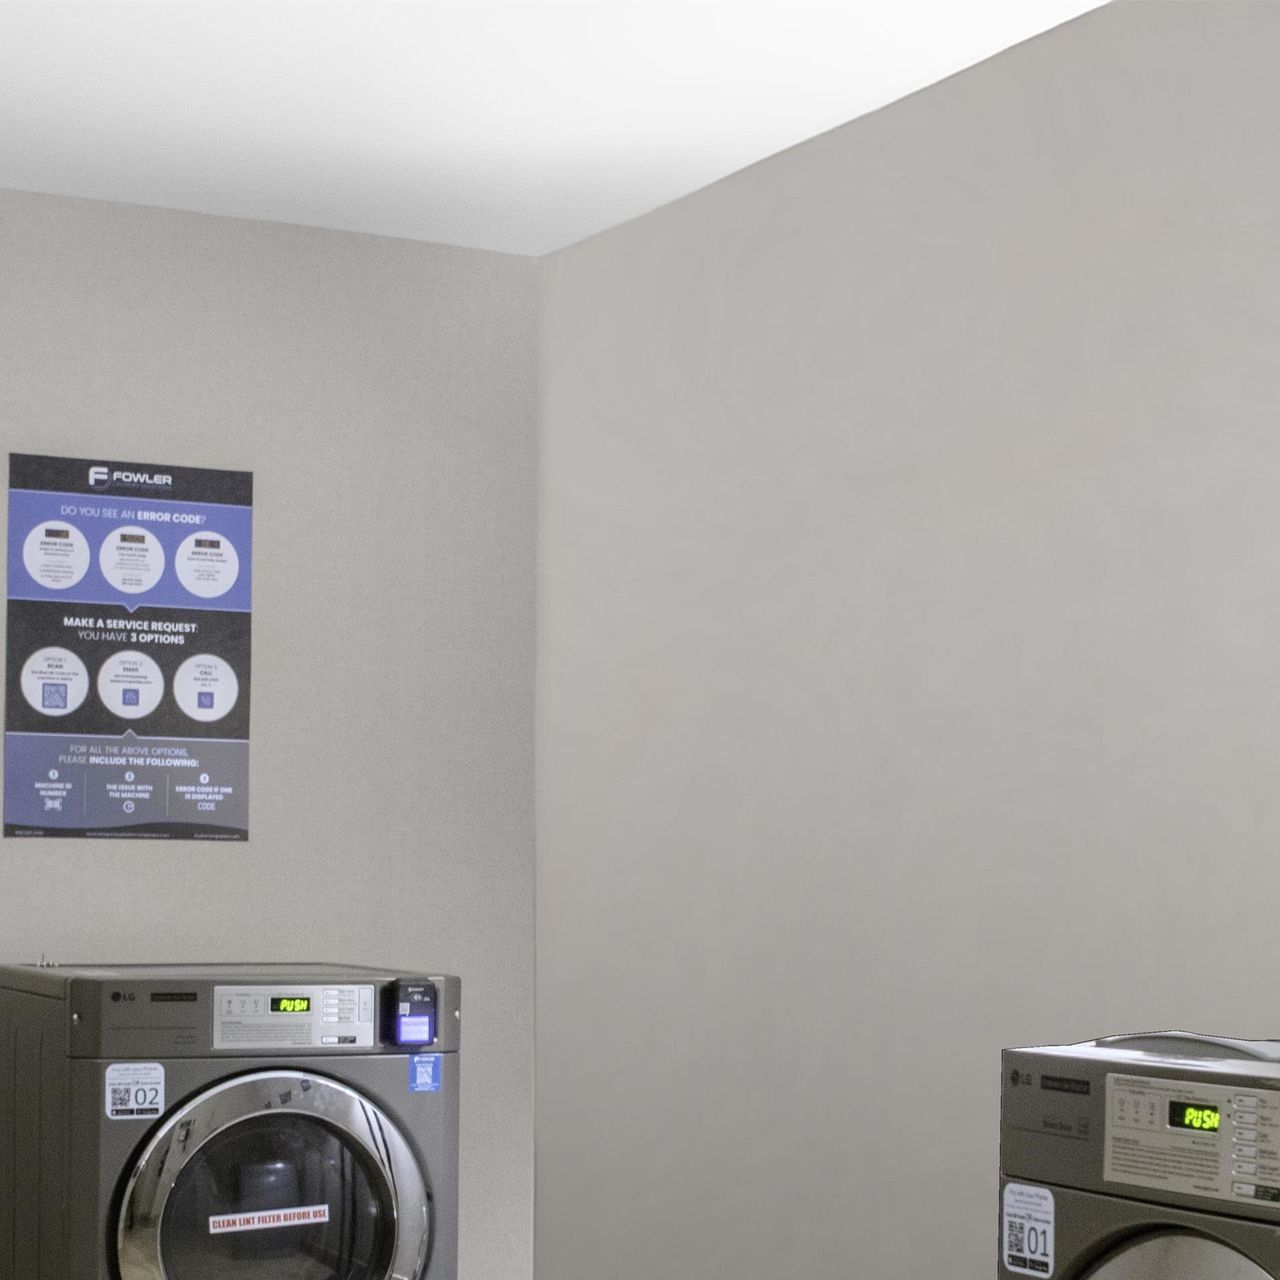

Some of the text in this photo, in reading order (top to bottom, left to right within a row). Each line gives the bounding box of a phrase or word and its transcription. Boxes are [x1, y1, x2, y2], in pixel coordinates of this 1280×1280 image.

[113, 471, 172, 485] FOWLER
[61, 505, 207, 525] DO YOU SEE AN ERROR CODE?
[64, 616, 94, 629] MAKE
[96, 618, 105, 629] A
[106, 619, 149, 631] SERVICE
[78, 630, 185, 645] YOU HAVE 3 OPTIONS
[70, 744, 87, 753] FOR
[89, 745, 103, 754] ALL
[105, 746, 119, 755] THE
[121, 746, 149, 756] ABOVE
[59, 754, 200, 768] PLEASE INCLUDE THE FOLLOWING:
[35, 782, 67, 790] MACHINE
[106, 783, 153, 793] THE ISSUE WITH
[220, 786, 233, 794] ONE
[121, 791, 150, 799] MACHINE
[191, 793, 224, 801] DISPLAYED
[197, 802, 216, 811] CODE
[123, 993, 136, 1001] LG
[280, 998, 308, 1012] PUSH
[134, 1087, 160, 1106] 02
[1184, 1107, 1219, 1129] PUSH
[212, 1209, 327, 1230] CLEAN LINT FILTER BEFORE USE
[1028, 1226, 1049, 1257] 01
